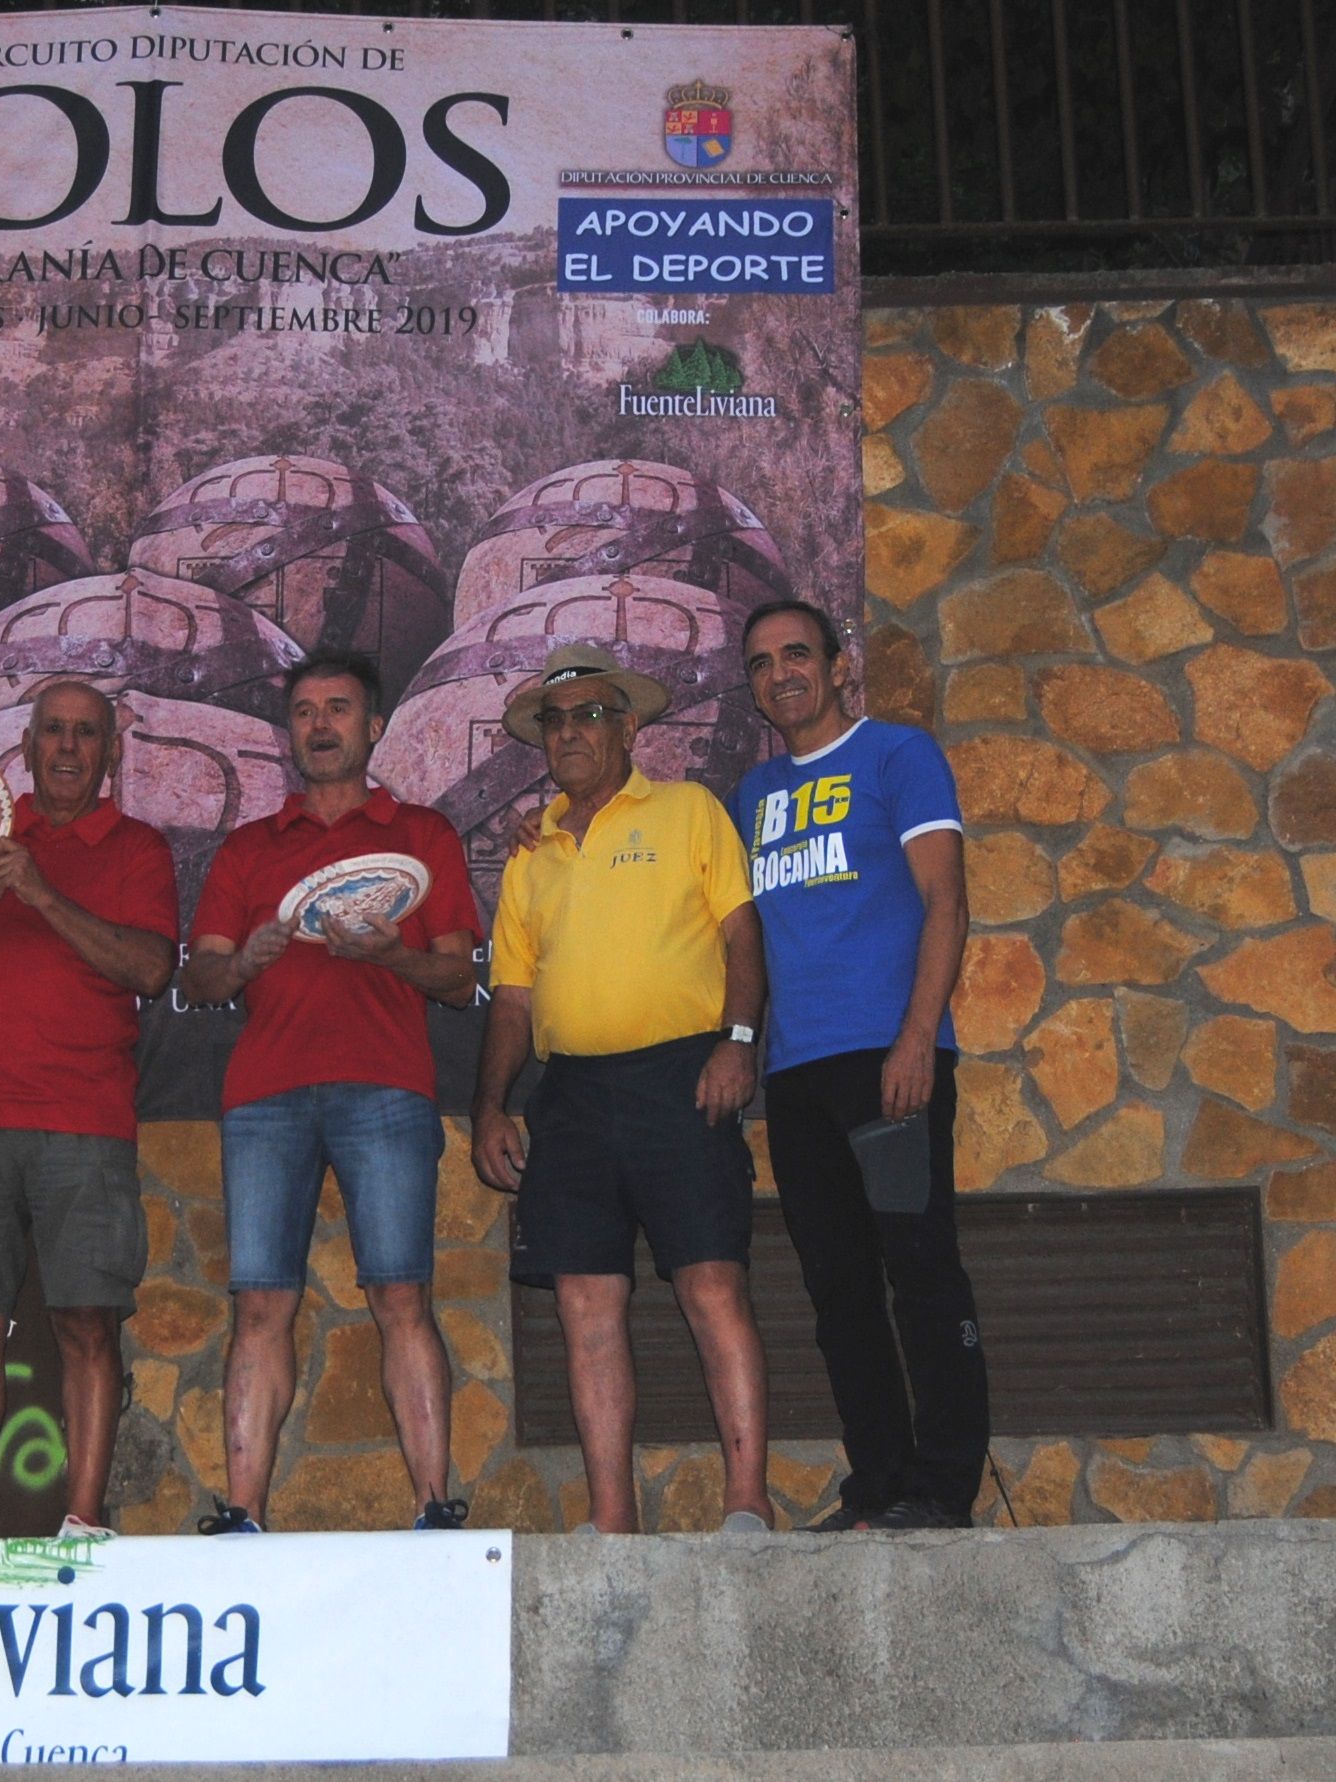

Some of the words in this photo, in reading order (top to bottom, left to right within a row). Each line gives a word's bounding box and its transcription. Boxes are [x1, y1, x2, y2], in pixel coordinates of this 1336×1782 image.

[130, 34, 347, 69] DIPUTACIÓN
[361, 47, 405, 71] DE
[561, 170, 655, 184] DIPUTACIÓN
[655, 171, 744, 184] PROVINCIAL
[746, 171, 766, 184] DE
[769, 171, 833, 185] CUENCA
[575, 209, 814, 237] APOYANDO
[137, 243, 187, 281] DE
[565, 253, 613, 282] EL
[632, 254, 825, 283] DEPORTE
[174, 304, 383, 333] SEPTIEMBRE
[395, 306, 478, 336] 2019
[636, 309, 710, 325] COLABORA:
[618, 384, 777, 417] FuenteLiviana
[609, 852, 657, 870] JUEZ
[753, 832, 848, 896] BOCAINA
[1, 1728, 128, 1764] Cuenca
